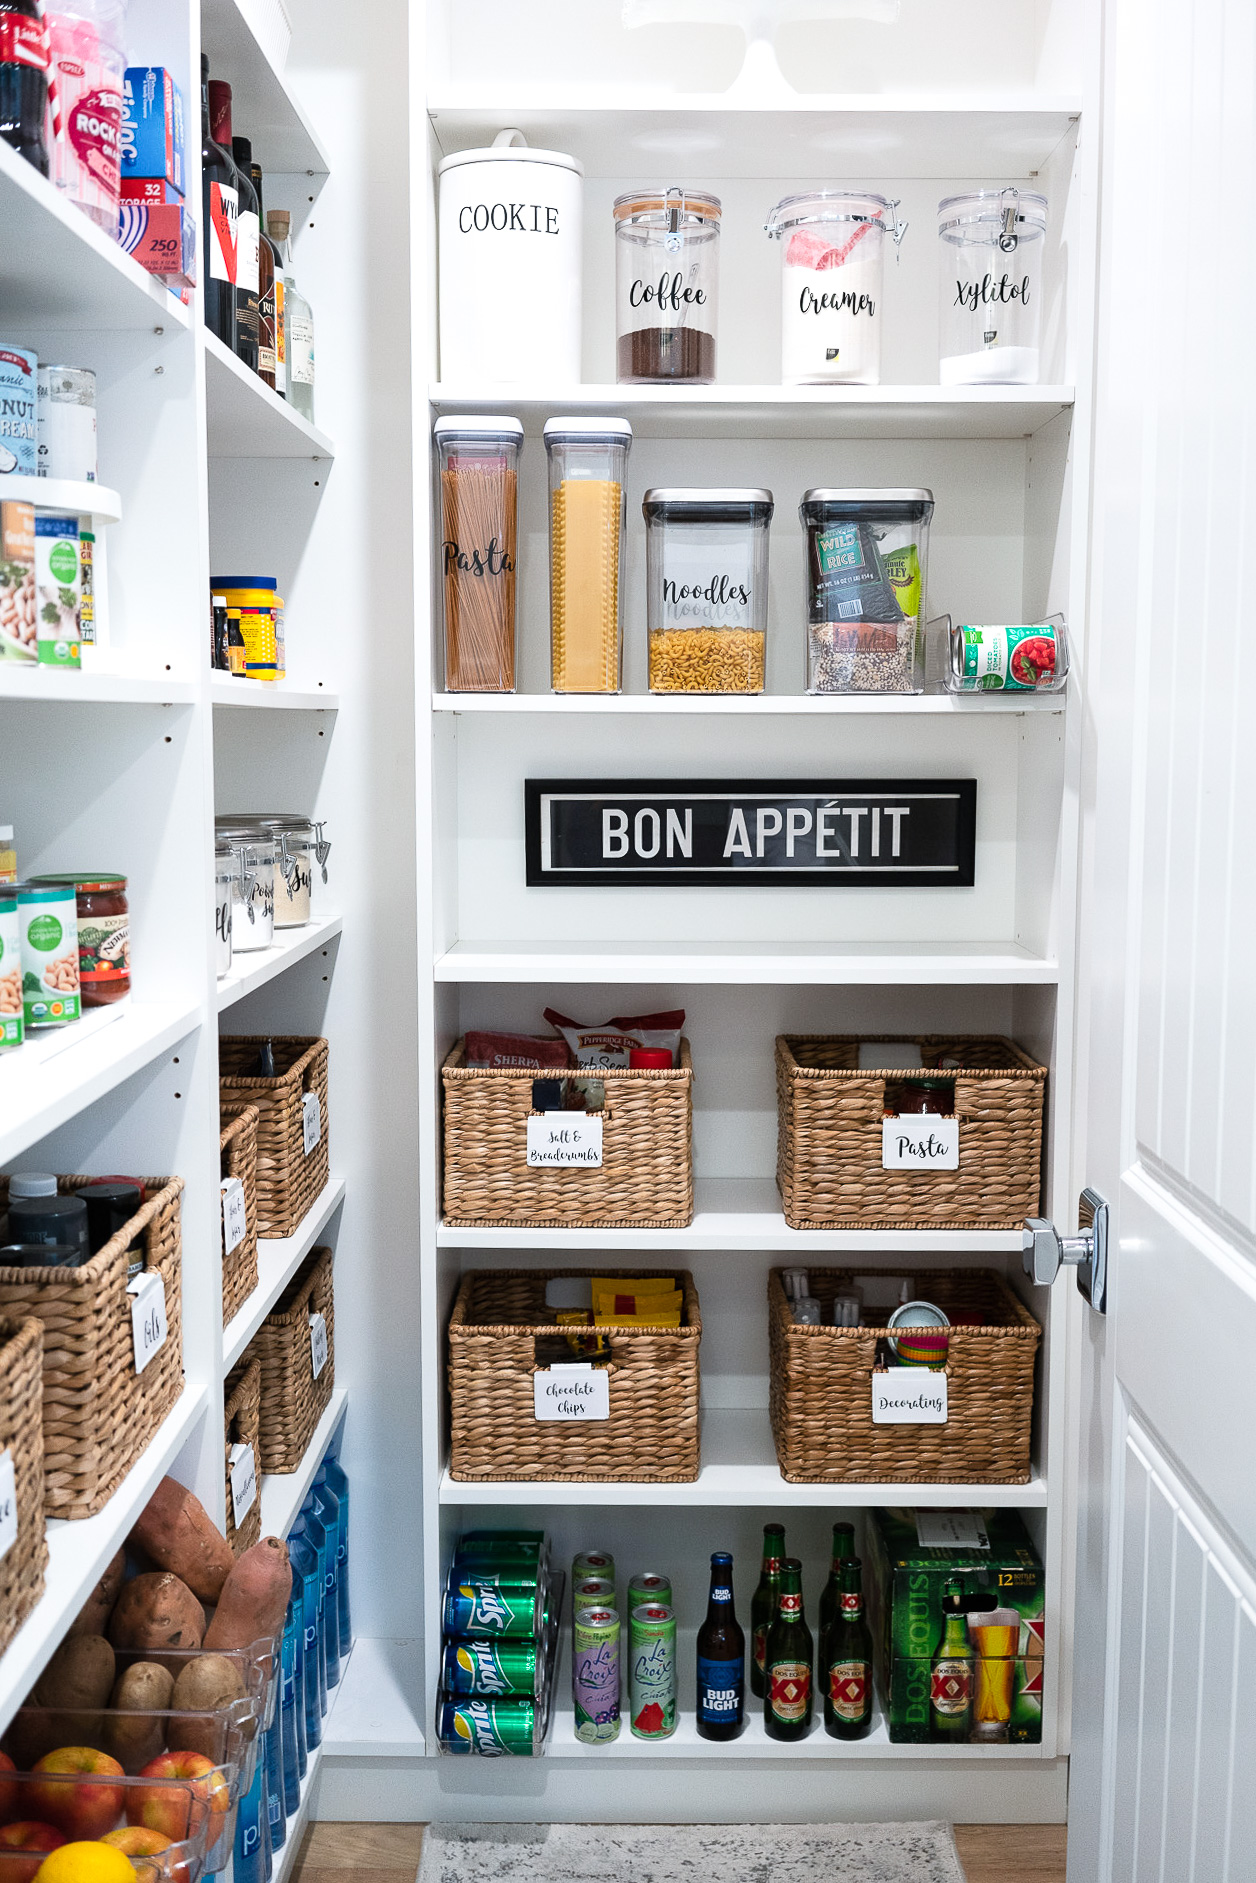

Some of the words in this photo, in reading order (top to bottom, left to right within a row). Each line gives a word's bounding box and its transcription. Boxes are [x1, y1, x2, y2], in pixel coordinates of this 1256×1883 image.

[77, 113, 116, 144] ROCK
[144, 184, 161, 196] 32
[459, 203, 560, 234] COOKIE
[149, 239, 177, 252] 250
[629, 272, 707, 311] Coffee
[953, 273, 1031, 312] Xylitol
[799, 286, 876, 316] Creamer
[820, 533, 856, 552] WILD
[442, 537, 517, 577] Pasta
[827, 552, 856, 569] RICE
[663, 574, 751, 605] Noodles
[602, 808, 693, 858] BON
[723, 800, 910, 858] APPÉTIT
[581, 1035, 622, 1045] PEPPERIDGE
[493, 1054, 540, 1069] SHERPA
[547, 1130, 571, 1144] Salt
[573, 1130, 582, 1142] &
[895, 1133, 949, 1159] Pasta
[530, 1149, 599, 1163] Breadcrumbs
[546, 1382, 596, 1396] Chocolate
[557, 1400, 586, 1416] Chips
[879, 1394, 945, 1412] Decorating
[998, 1574, 1014, 1587] 12
[909, 1573, 929, 1658] EQUIS
[707, 1689, 735, 1700] BUD
[906, 1665, 928, 1724] DOS
[703, 1697, 739, 1711] LIGHT
